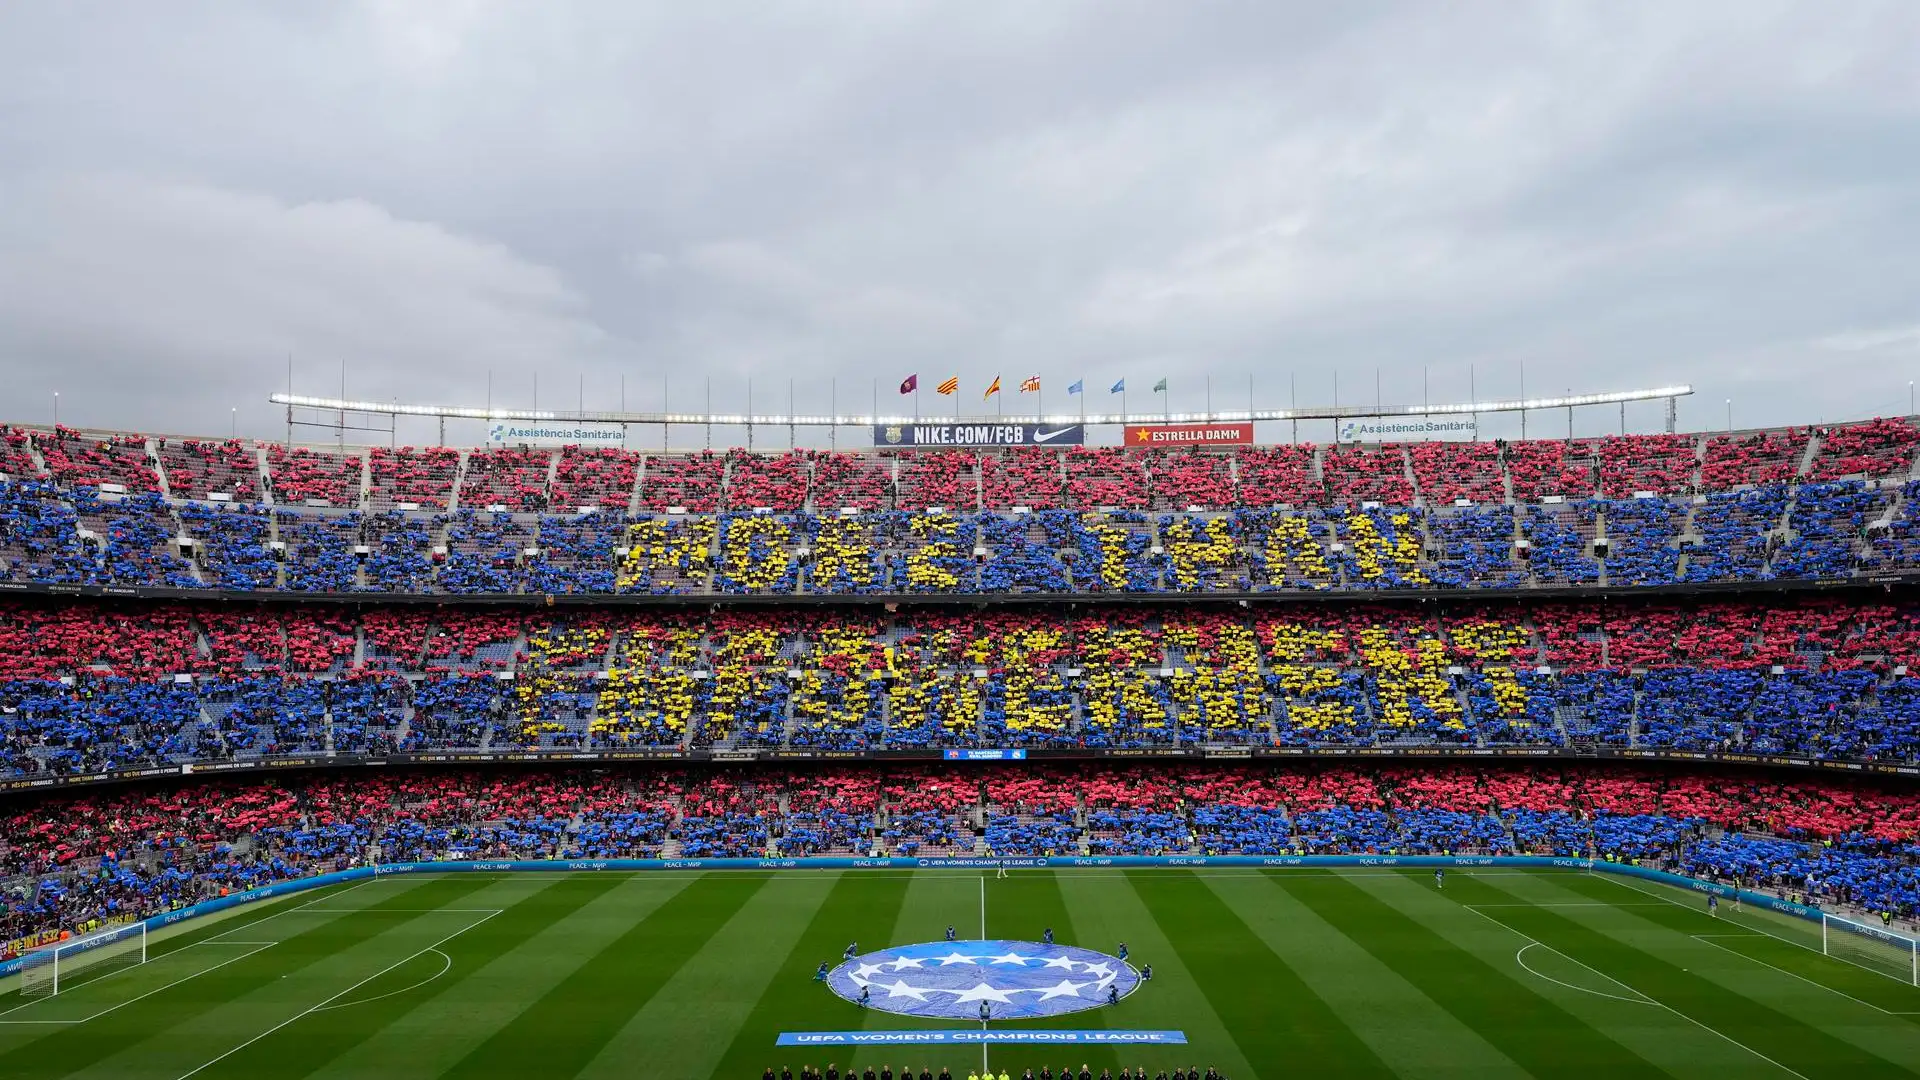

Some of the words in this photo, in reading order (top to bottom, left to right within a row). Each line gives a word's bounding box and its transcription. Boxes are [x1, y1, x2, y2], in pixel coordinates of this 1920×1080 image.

[508, 427, 572, 439] Assistència
[573, 429, 622, 441] Sanitària
[1360, 423, 1424, 434] Assistència
[1425, 421, 1475, 432] Sanitària
[914, 426, 1024, 444] NIKE.COM/FCB
[1152, 429, 1204, 442] ESTRELLA
[1206, 428, 1240, 441] DAMM
[375, 866, 393, 874] PEACE
[240, 894, 256, 902] PEACE
[260, 889, 272, 897] МИР
[1692, 883, 1708, 892] PEACE
[1713, 886, 1725, 895] МИР
[1772, 901, 1789, 911] PEACE
[1794, 905, 1807, 915] МИР
[165, 914, 180, 923] PEACE
[184, 909, 195, 918] МИР
[7, 961, 23, 972] МИР
[851, 1033, 945, 1041] WOMEN'S
